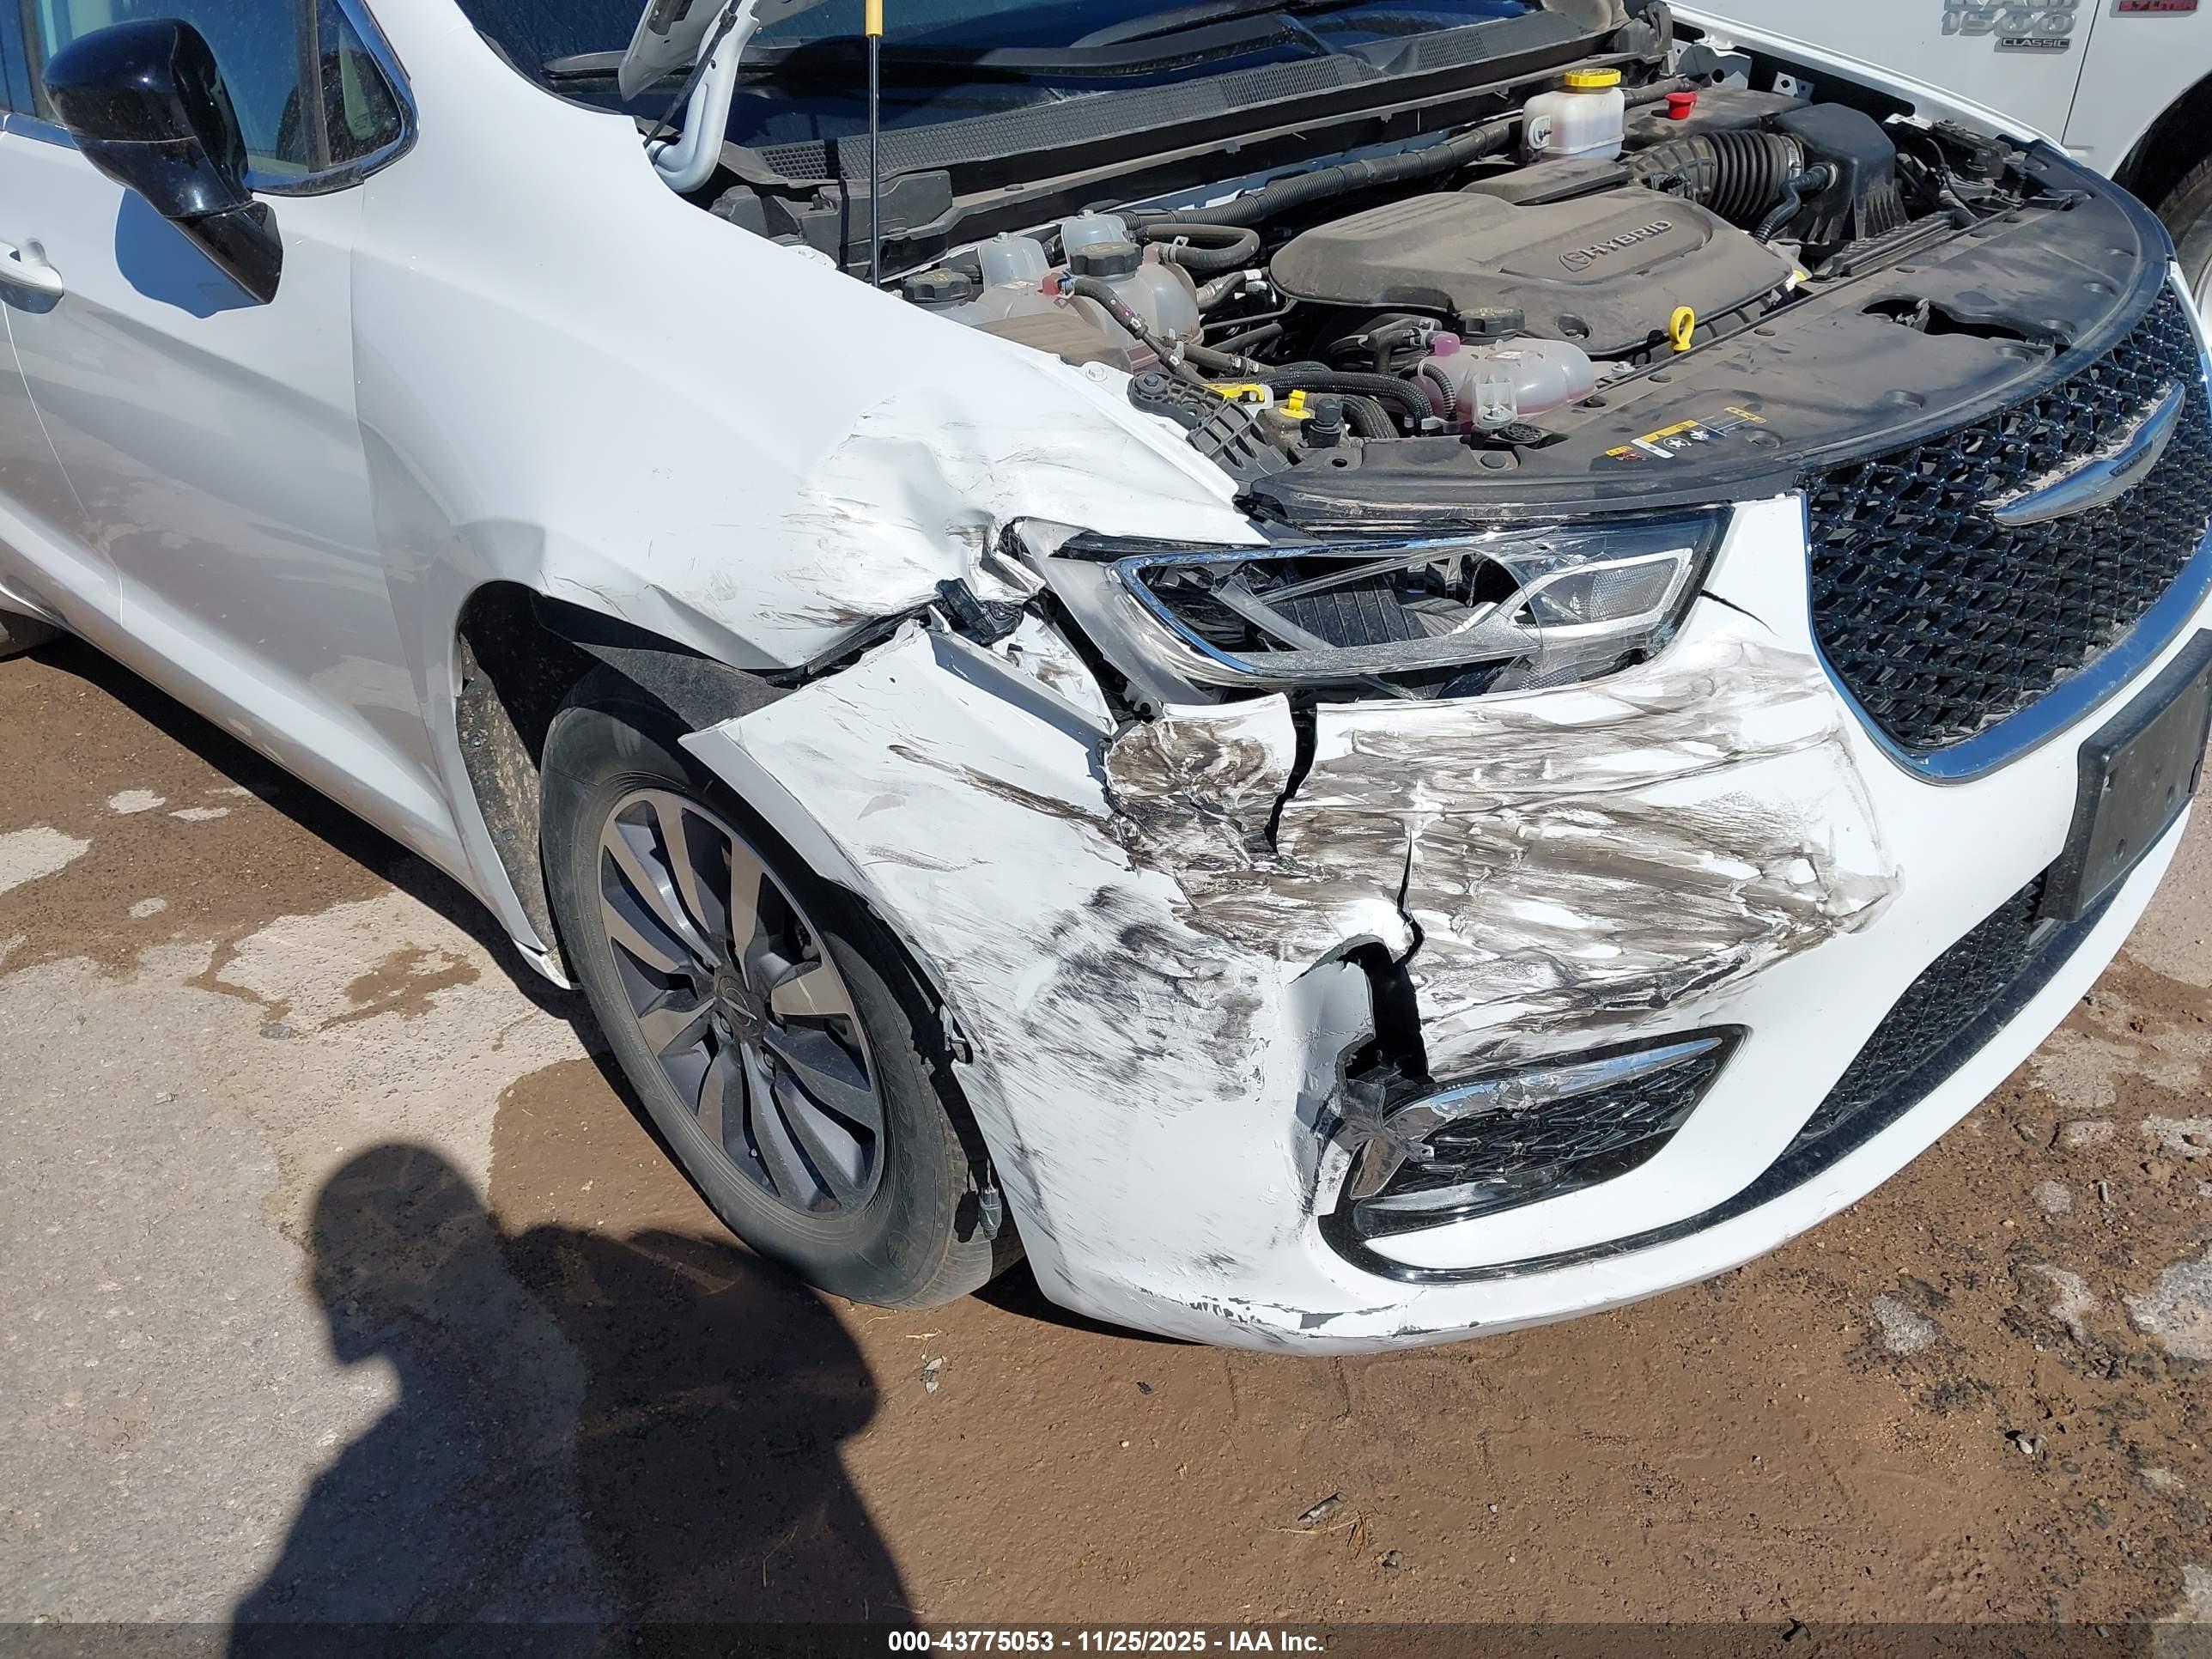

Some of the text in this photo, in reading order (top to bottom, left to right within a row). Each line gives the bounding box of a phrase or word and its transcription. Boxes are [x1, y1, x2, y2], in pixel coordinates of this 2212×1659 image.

[1942, 10, 2076, 36] 1500
[2002, 39, 2069, 48] CLASSIC
[1580, 220, 1673, 260] HYBRID
